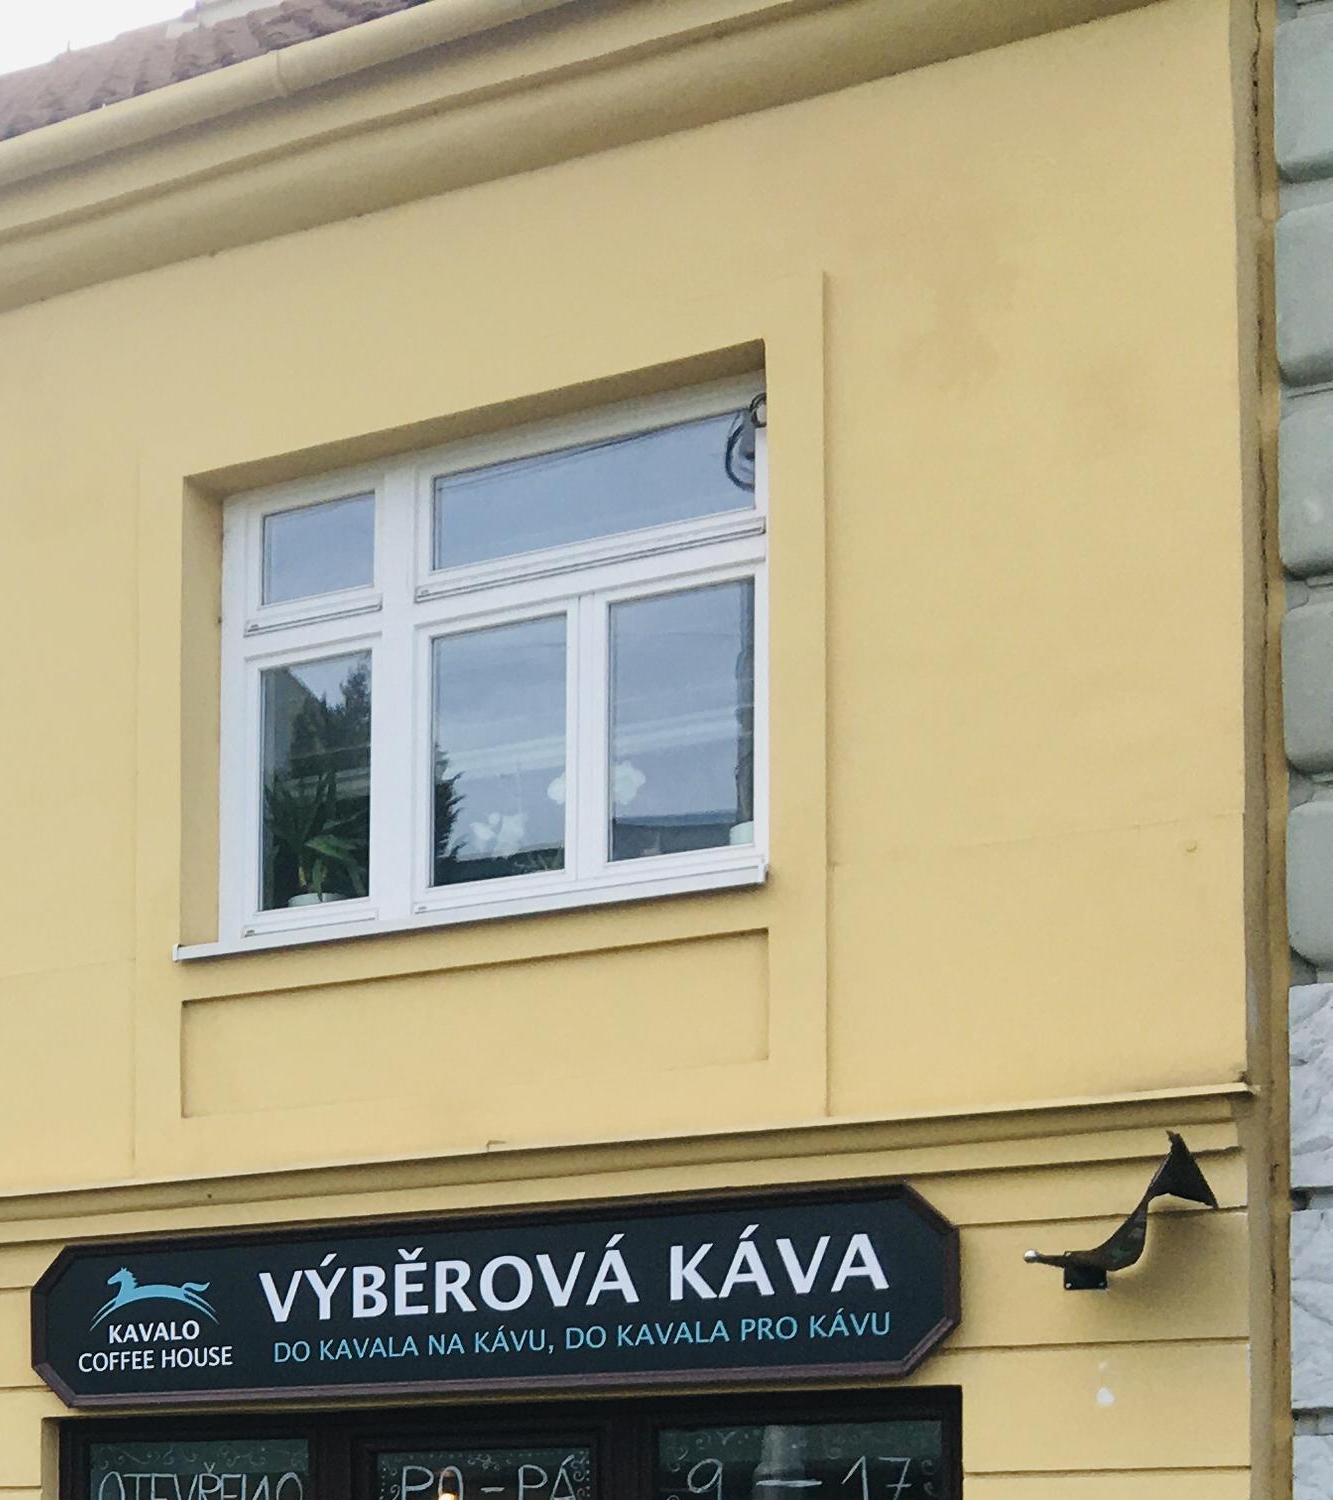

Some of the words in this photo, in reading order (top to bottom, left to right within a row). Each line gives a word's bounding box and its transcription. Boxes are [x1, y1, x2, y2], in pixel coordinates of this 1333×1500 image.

[258, 1233, 639, 1323] VÝBĚROVÁ
[670, 1223, 889, 1301] KÁVA
[109, 1320, 200, 1344] KAVALO
[274, 1341, 310, 1363] DO
[320, 1335, 419, 1361] KAVALA
[429, 1333, 465, 1356] NA
[475, 1325, 553, 1355] KÁVU,
[565, 1325, 607, 1350] DO
[617, 1319, 730, 1347] KAVALA
[741, 1316, 798, 1341] PRO
[809, 1308, 890, 1339] KÁVU
[78, 1349, 155, 1373] COFFEE
[162, 1345, 233, 1369] HOUSE
